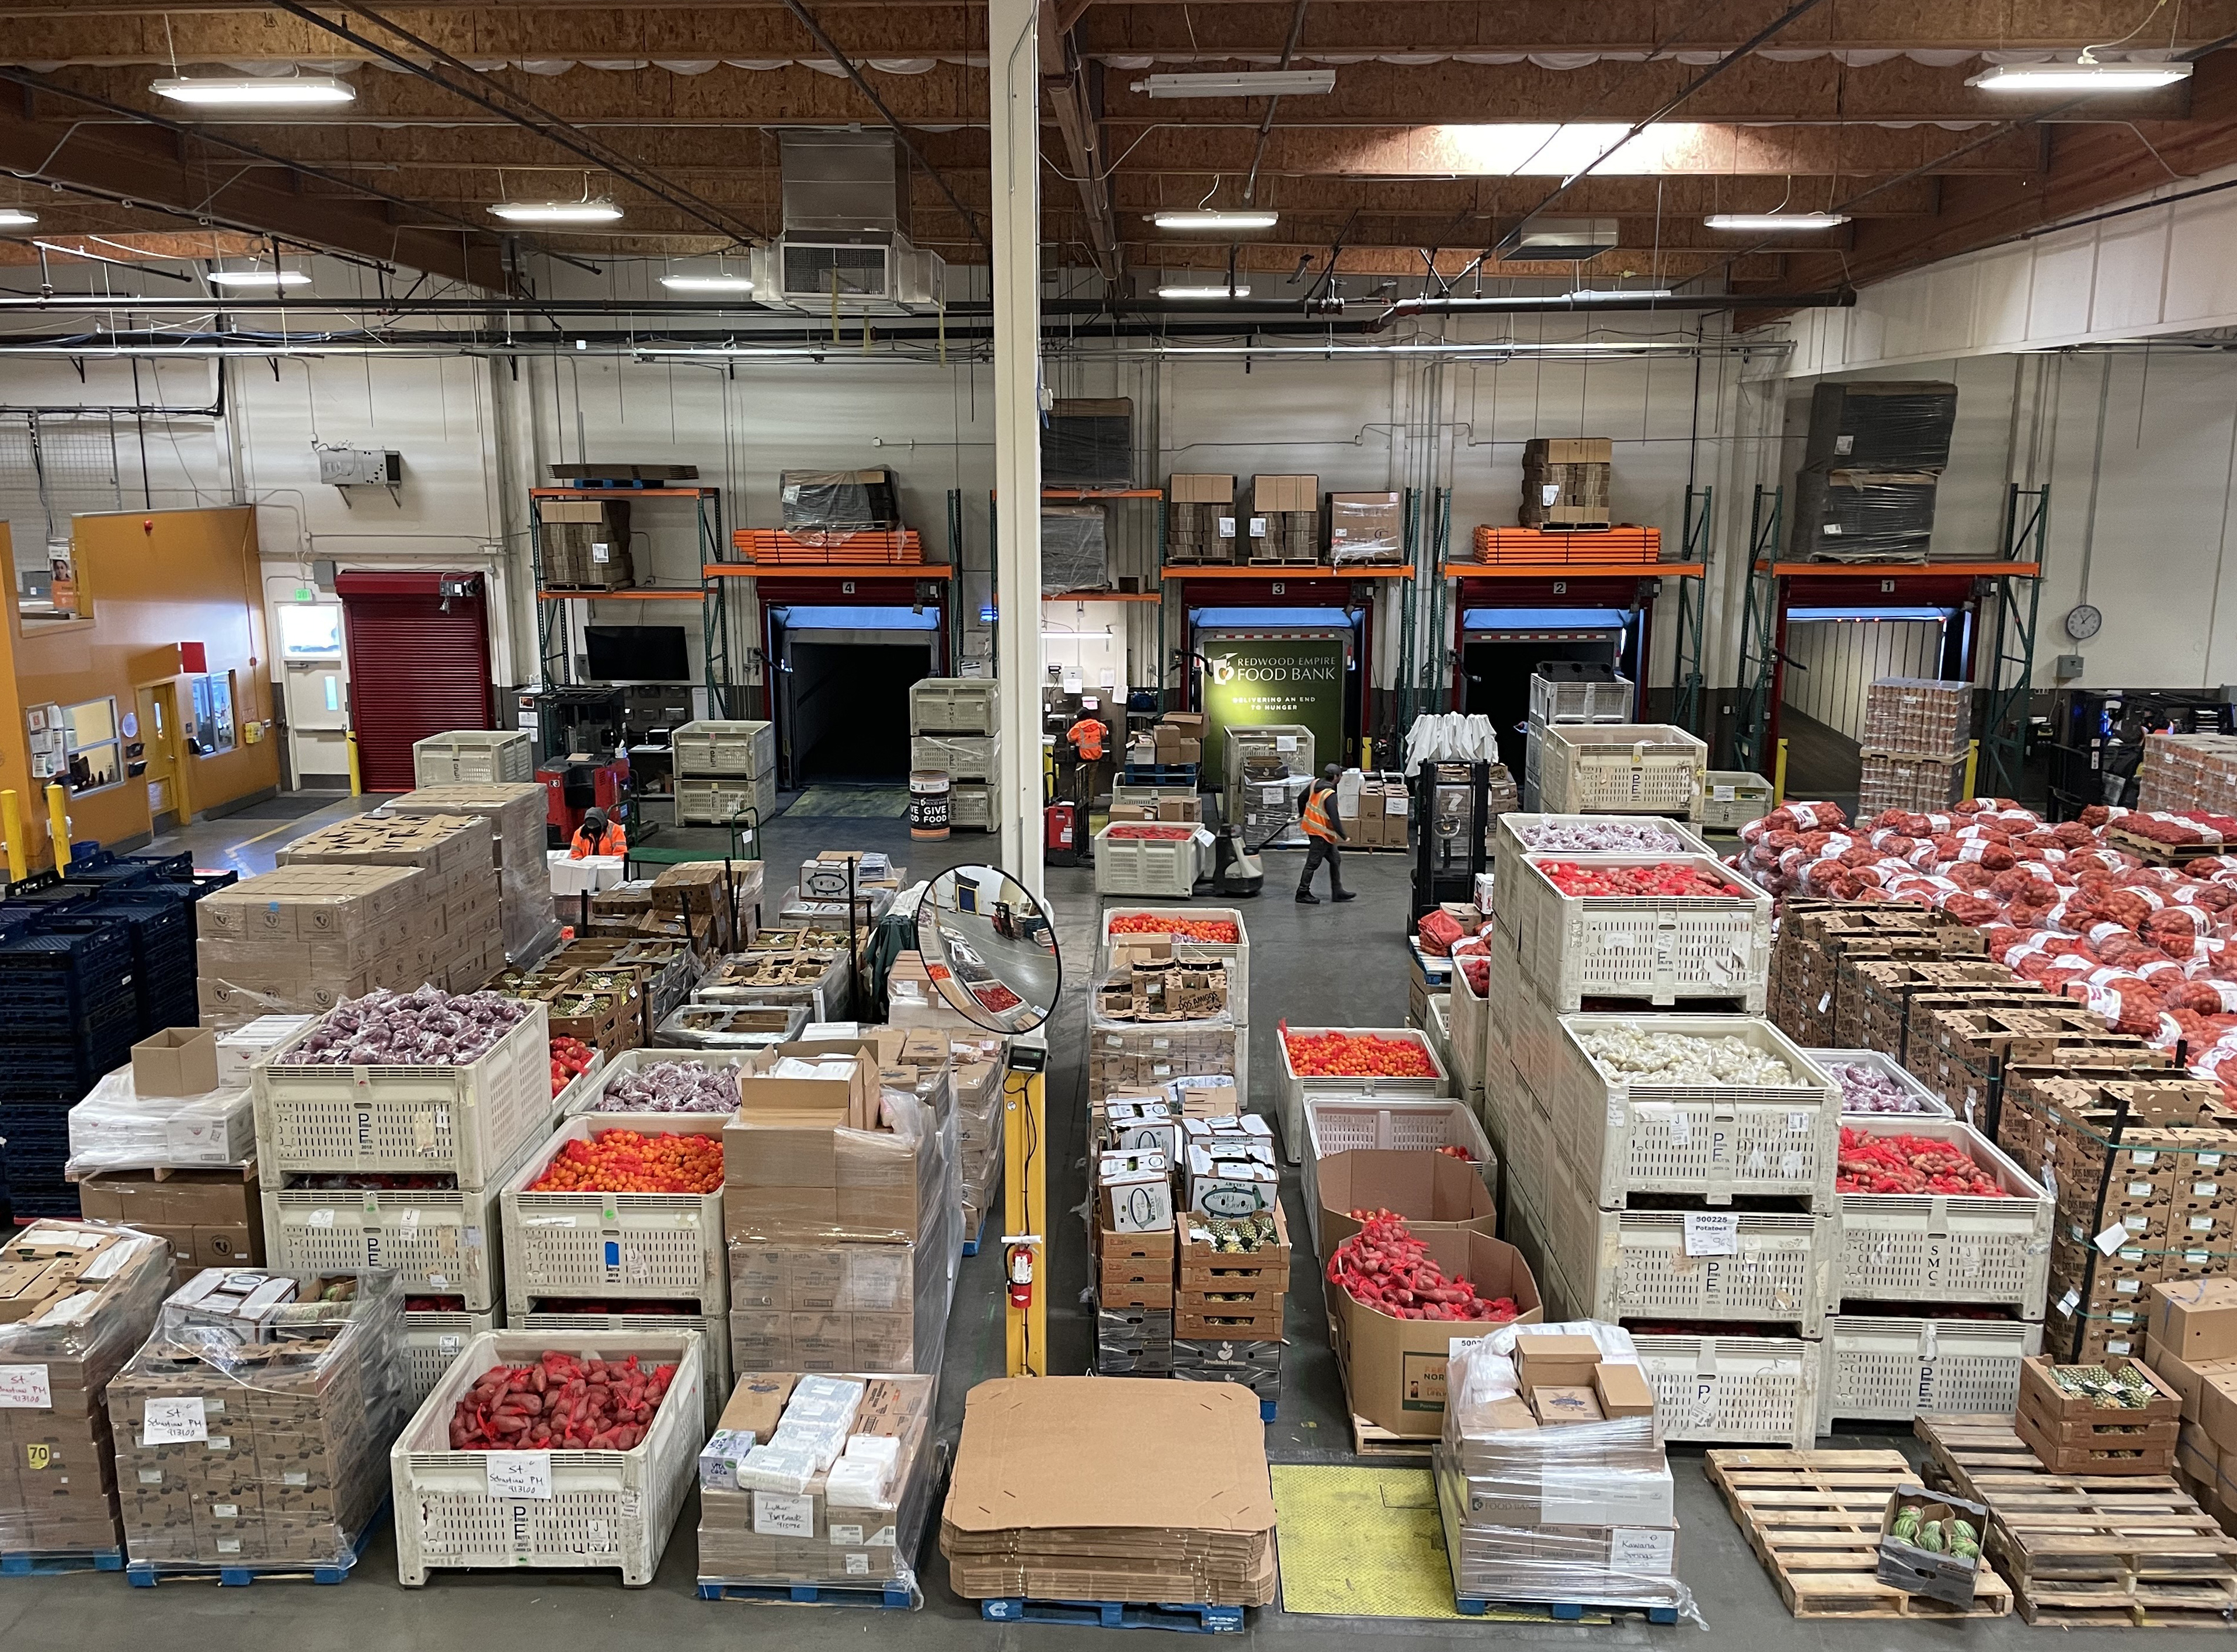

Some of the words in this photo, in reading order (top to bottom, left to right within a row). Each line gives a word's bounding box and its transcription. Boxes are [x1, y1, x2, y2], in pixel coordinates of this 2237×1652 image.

[845, 584, 852, 593] 4
[1275, 584, 1283, 593] 3
[1556, 583, 1564, 593] 2
[1885, 582, 1891, 591] 1
[1238, 658, 1295, 666] REDWOOD
[1299, 657, 1335, 665] EMPIRE
[1237, 668, 1286, 681] FOOD
[1292, 667, 1335, 680] BANK
[924, 805, 947, 815] GIVE
[924, 815, 947, 823] FOOD
[1178, 1000, 1192, 1010] DOS
[1193, 991, 1218, 1004] AMIGOS
[32, 1386, 47, 1394] PM
[188, 1419, 202, 1428] PM
[167, 1428, 195, 1437] 913100
[29, 1447, 47, 1460] 70
[530, 1476, 544, 1486] PM
[508, 1486, 536, 1494] 913100
[1485, 1501, 1513, 1510] FOOD
[1622, 1540, 1656, 1549] Kawana
